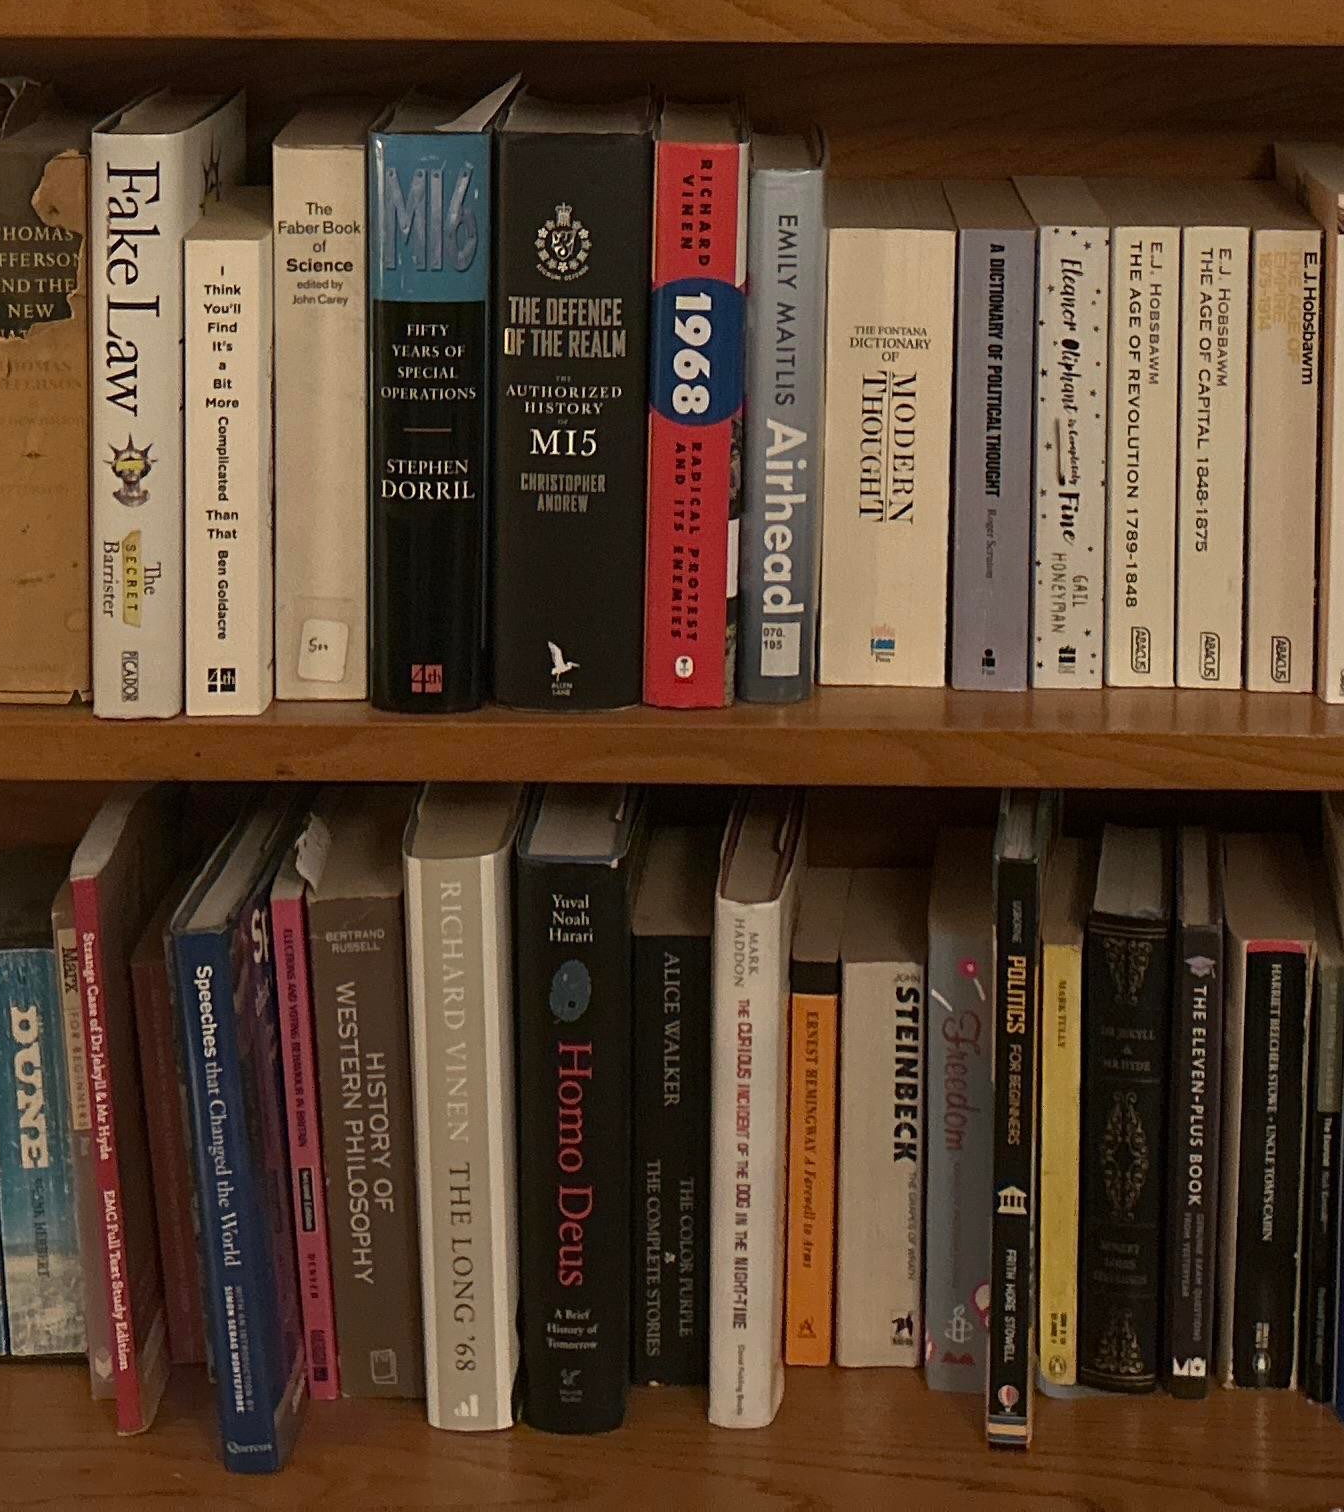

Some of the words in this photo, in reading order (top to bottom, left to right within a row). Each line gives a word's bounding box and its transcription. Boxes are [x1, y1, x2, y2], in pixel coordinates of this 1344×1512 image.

[106, 160, 161, 286] Fake
[278, 220, 318, 234] Faber
[322, 220, 361, 234] Book
[384, 163, 478, 273] MI6
[286, 258, 352, 273] Science
[778, 214, 798, 290] EMILY
[204, 284, 241, 296] Think
[508, 297, 541, 324] THE
[545, 297, 622, 326] DEFENCE
[208, 322, 237, 333] Find
[504, 328, 526, 356] OF
[530, 328, 562, 356] THE
[568, 329, 626, 358] REALM
[104, 296, 160, 416] Law
[671, 290, 711, 416] 1968
[772, 302, 796, 406] MAITLIS
[206, 398, 238, 408] More
[507, 386, 622, 399] AUTHORIZED
[524, 402, 604, 416] HISTORY
[218, 416, 228, 502] Complicated
[530, 429, 597, 457] MI5
[858, 370, 888, 522] THOUGHT
[888, 372, 918, 524] MODERN
[381, 480, 475, 500] DORRIL
[387, 459, 468, 476] STEPHEN
[206, 510, 238, 521] Than
[208, 528, 238, 540] That
[762, 418, 808, 614] Airhead
[218, 550, 228, 576] Ben
[218, 580, 228, 640] Goldacre
[1006, 955, 1026, 1034] POLITICS
[893, 986, 920, 1161] STEINBECK
[555, 1040, 593, 1173] Homo
[555, 1185, 593, 1288] Deus
